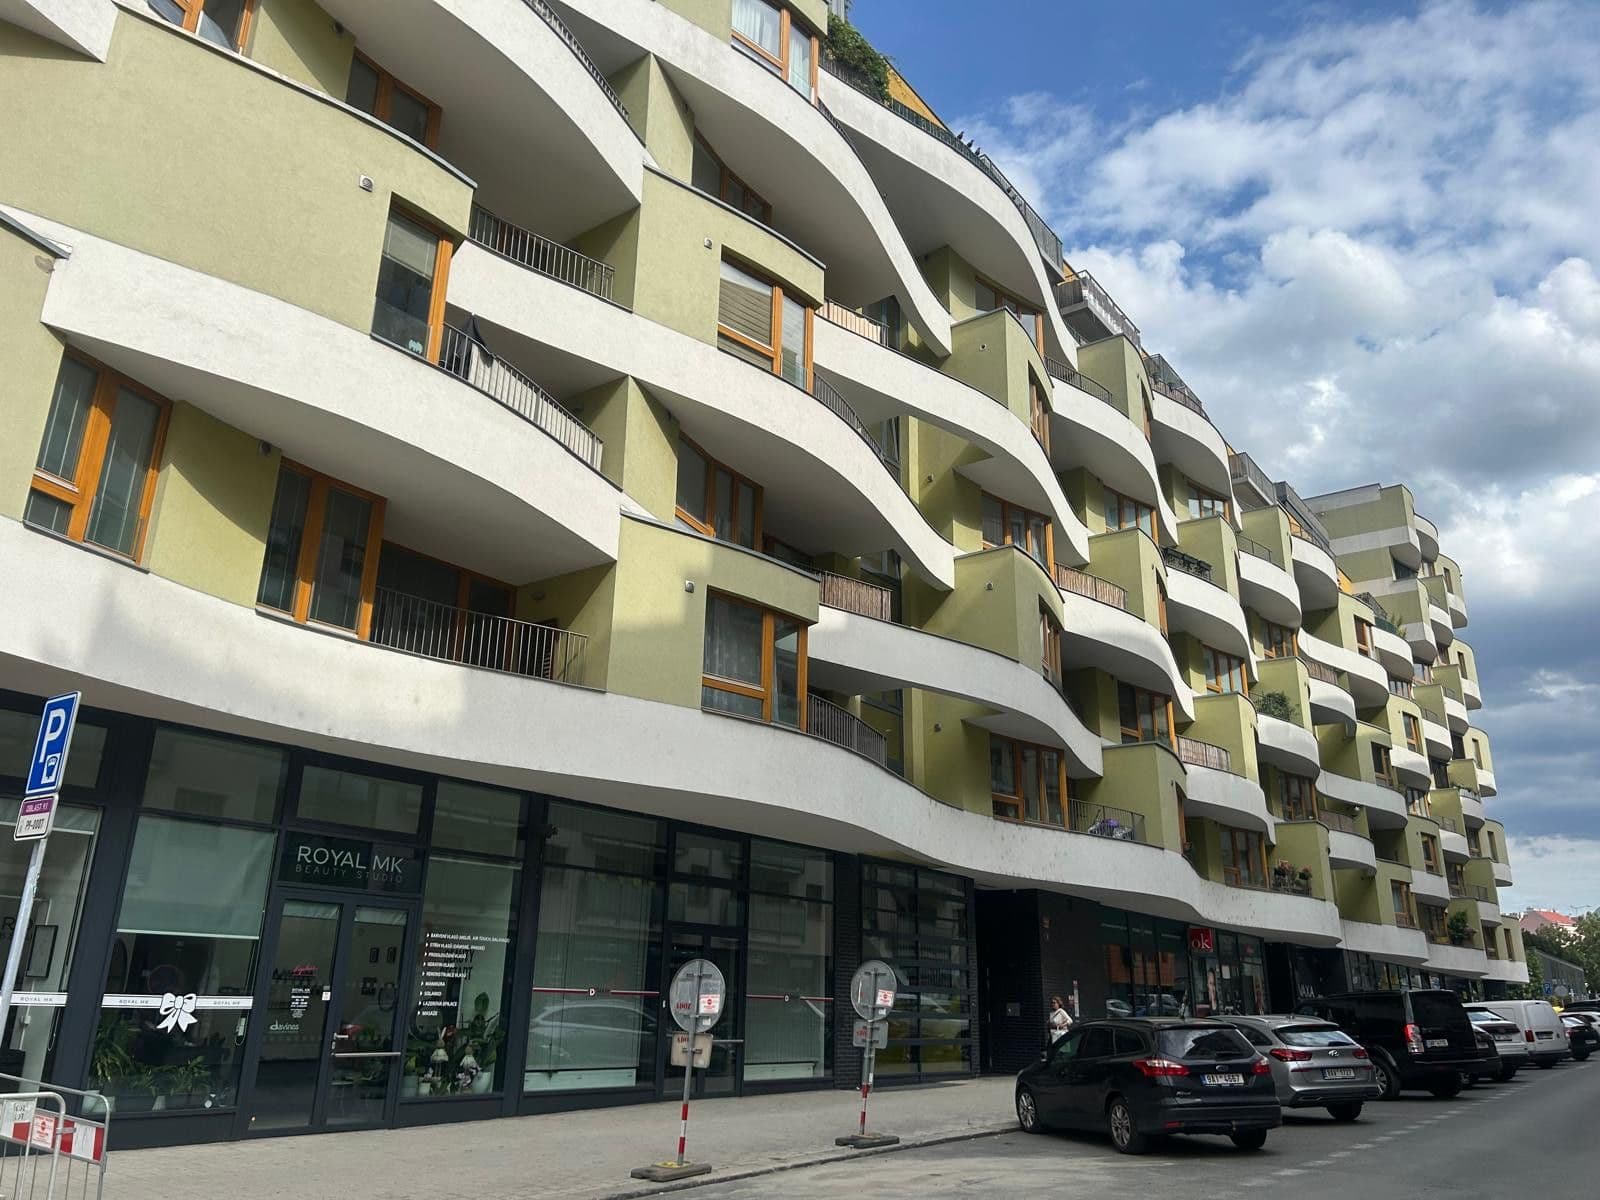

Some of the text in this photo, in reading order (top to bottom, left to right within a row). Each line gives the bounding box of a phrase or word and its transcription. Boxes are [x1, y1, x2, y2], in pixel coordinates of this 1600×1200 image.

[297, 845, 404, 873] ROYAL MK
[295, 863, 403, 883] BEAUTY STUDIO
[1191, 932, 1212, 950] ok
